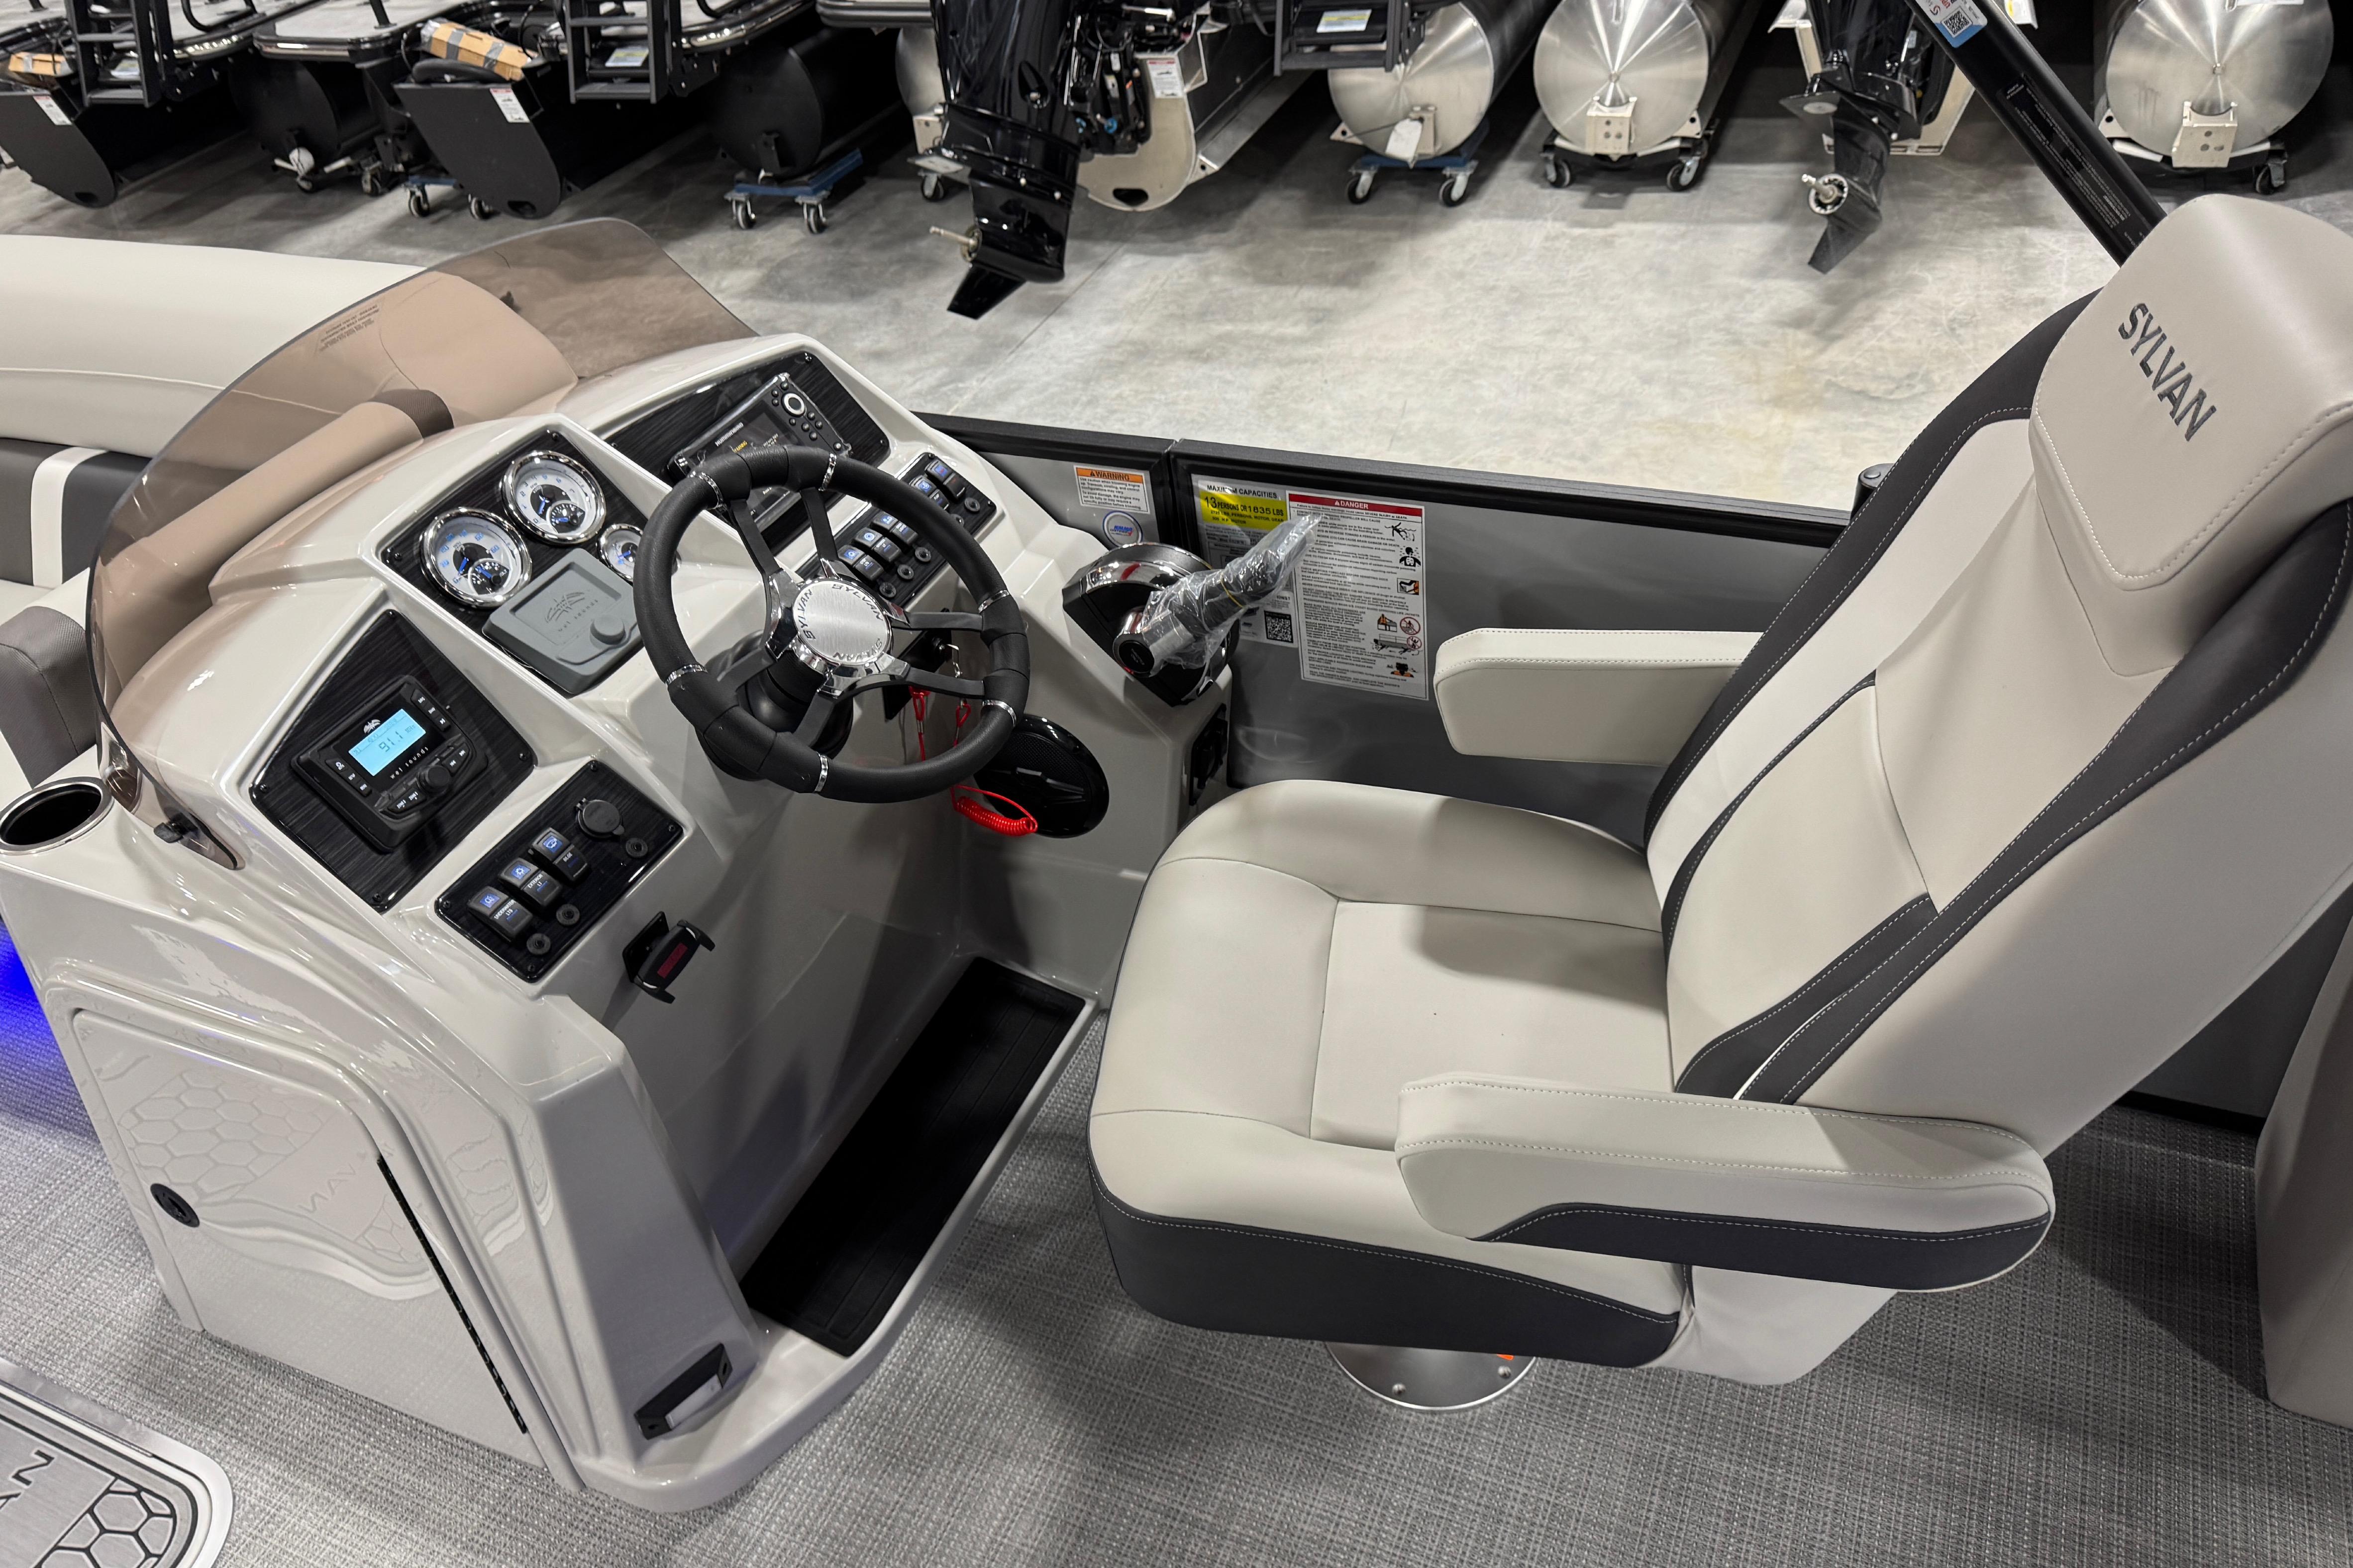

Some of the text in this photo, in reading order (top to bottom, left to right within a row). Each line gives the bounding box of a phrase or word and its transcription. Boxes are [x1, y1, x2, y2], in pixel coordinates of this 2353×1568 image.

[2118, 303, 2217, 442] SYLVAN
[1095, 471, 1129, 481] WARNING
[1207, 485, 1277, 498] MAXIMM CAPACITIES
[1205, 496, 1217, 508] 13
[1218, 502, 1239, 511] PERSONS
[1248, 505, 1271, 514] 1835
[1340, 500, 1368, 509] DANGER
[832, 584, 884, 621] SYLVAN
[798, 589, 816, 640] SYLVAN
[379, 731, 404, 752] 91.1
[390, 747, 428, 779] wet sounds
[527, 874, 544, 888] EXTERIOR
[494, 899, 517, 919] UNDERWATER
